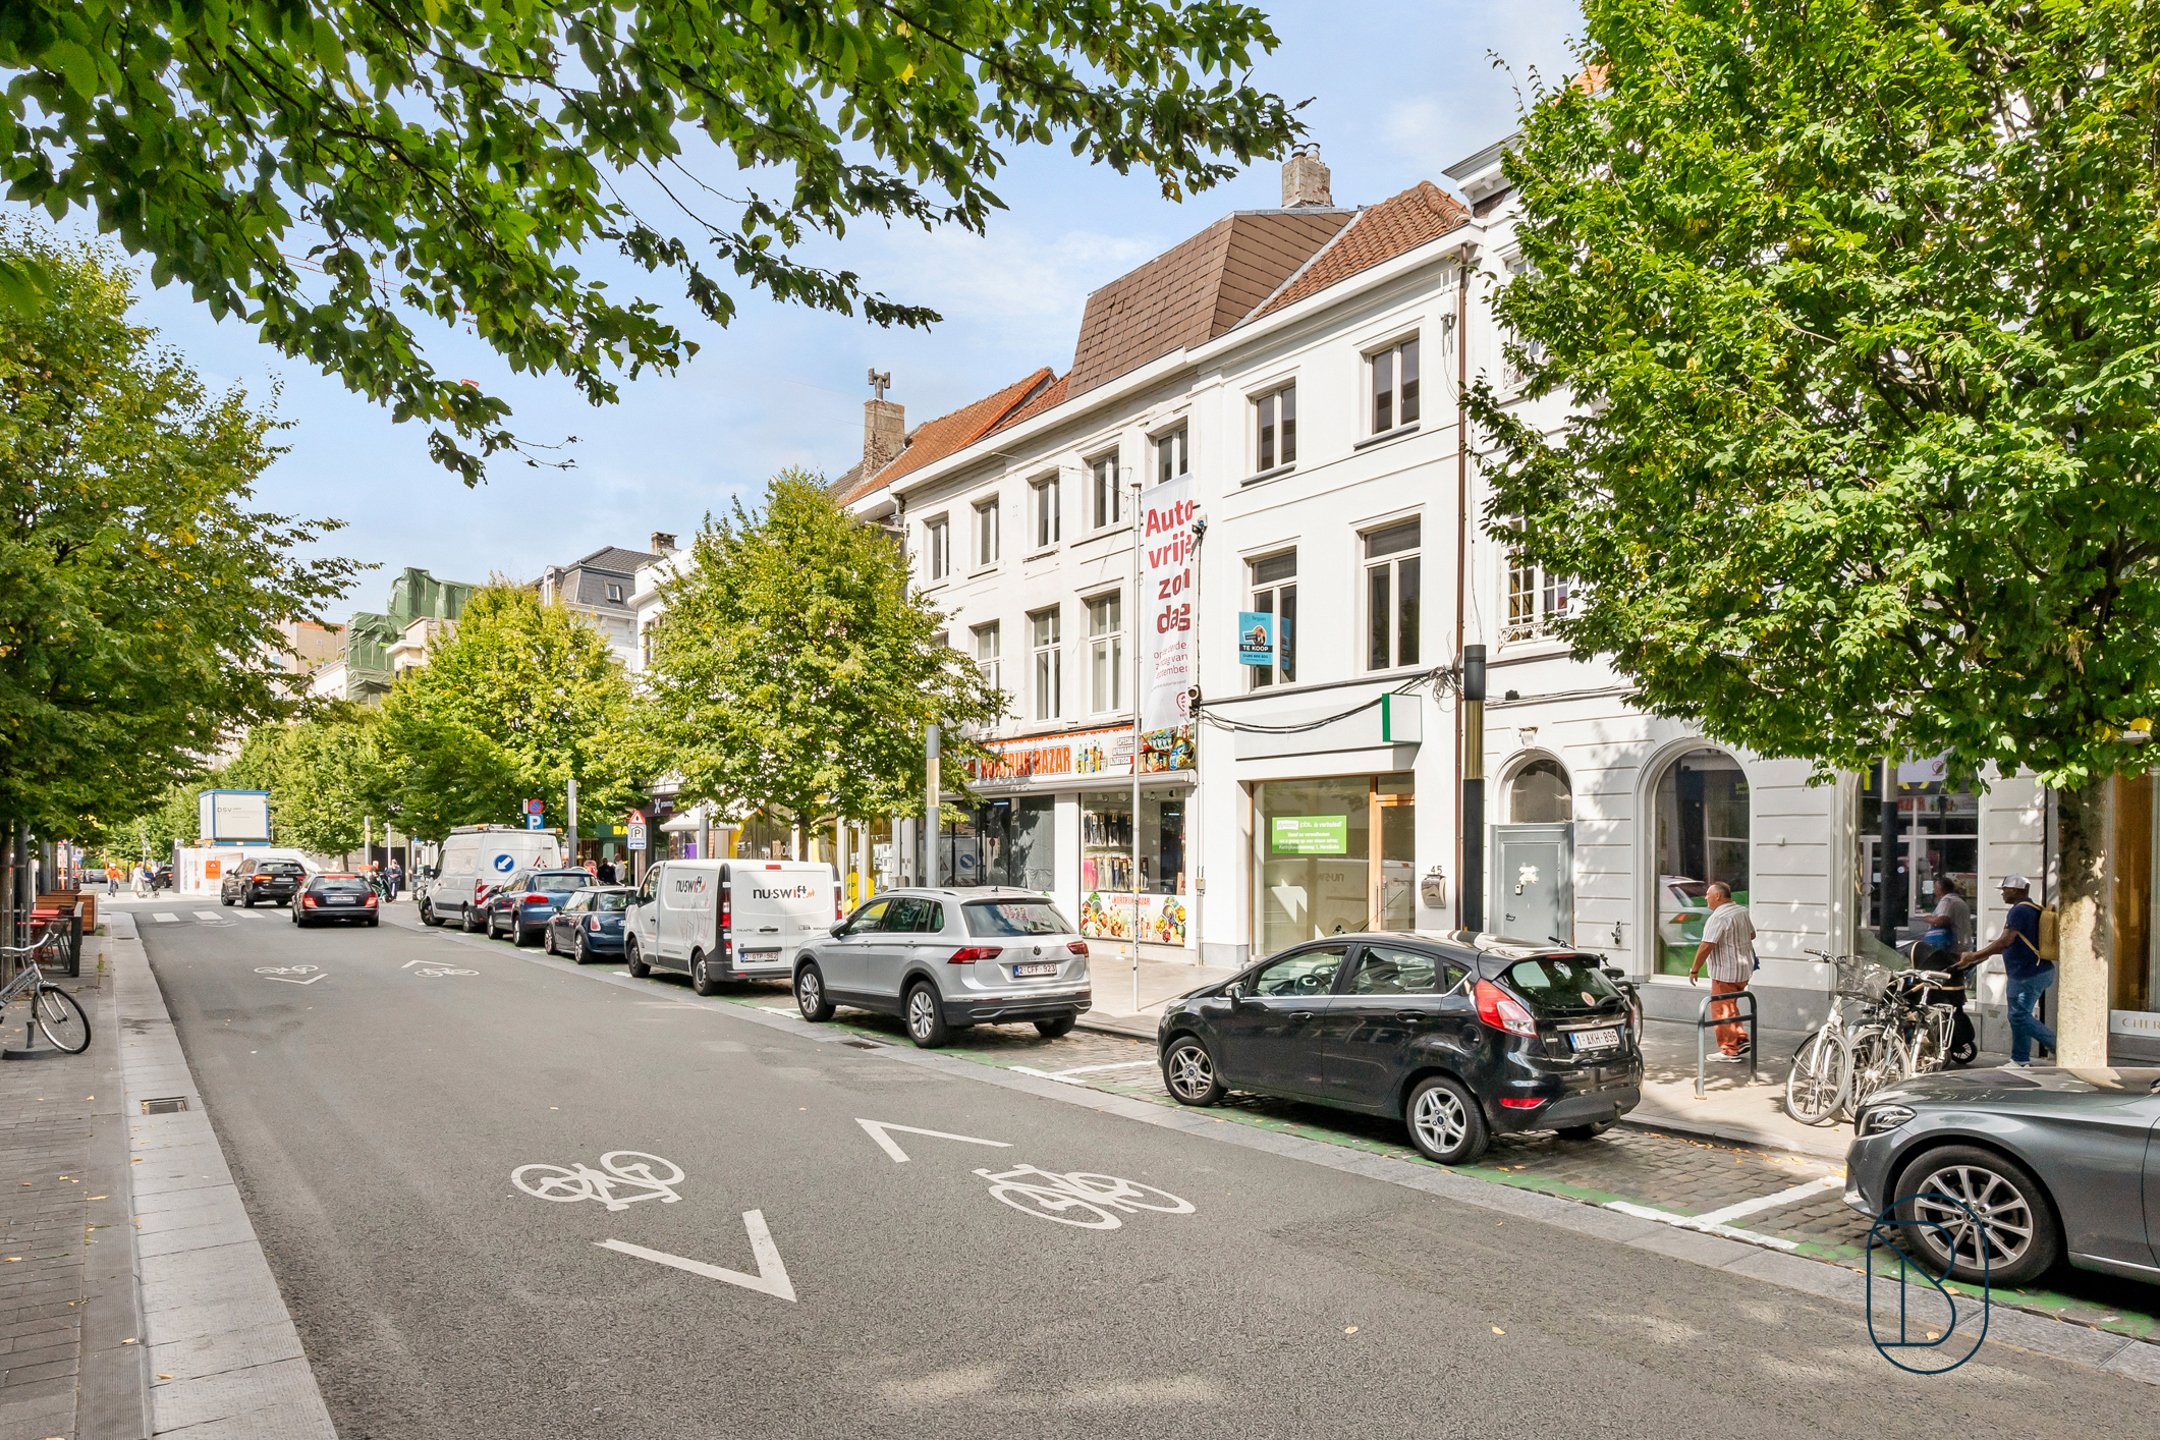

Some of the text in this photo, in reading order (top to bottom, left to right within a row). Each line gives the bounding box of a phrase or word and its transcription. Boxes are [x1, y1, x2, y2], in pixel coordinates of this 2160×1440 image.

[1145, 500, 1193, 537] Auto
[1171, 653, 1188, 663] van
[1033, 747, 1071, 775] BAZAR
[1430, 865, 1443, 874] 45
[1138, 897, 1151, 906] AZAR
[1576, 1030, 1618, 1047] 1-AKH-896
